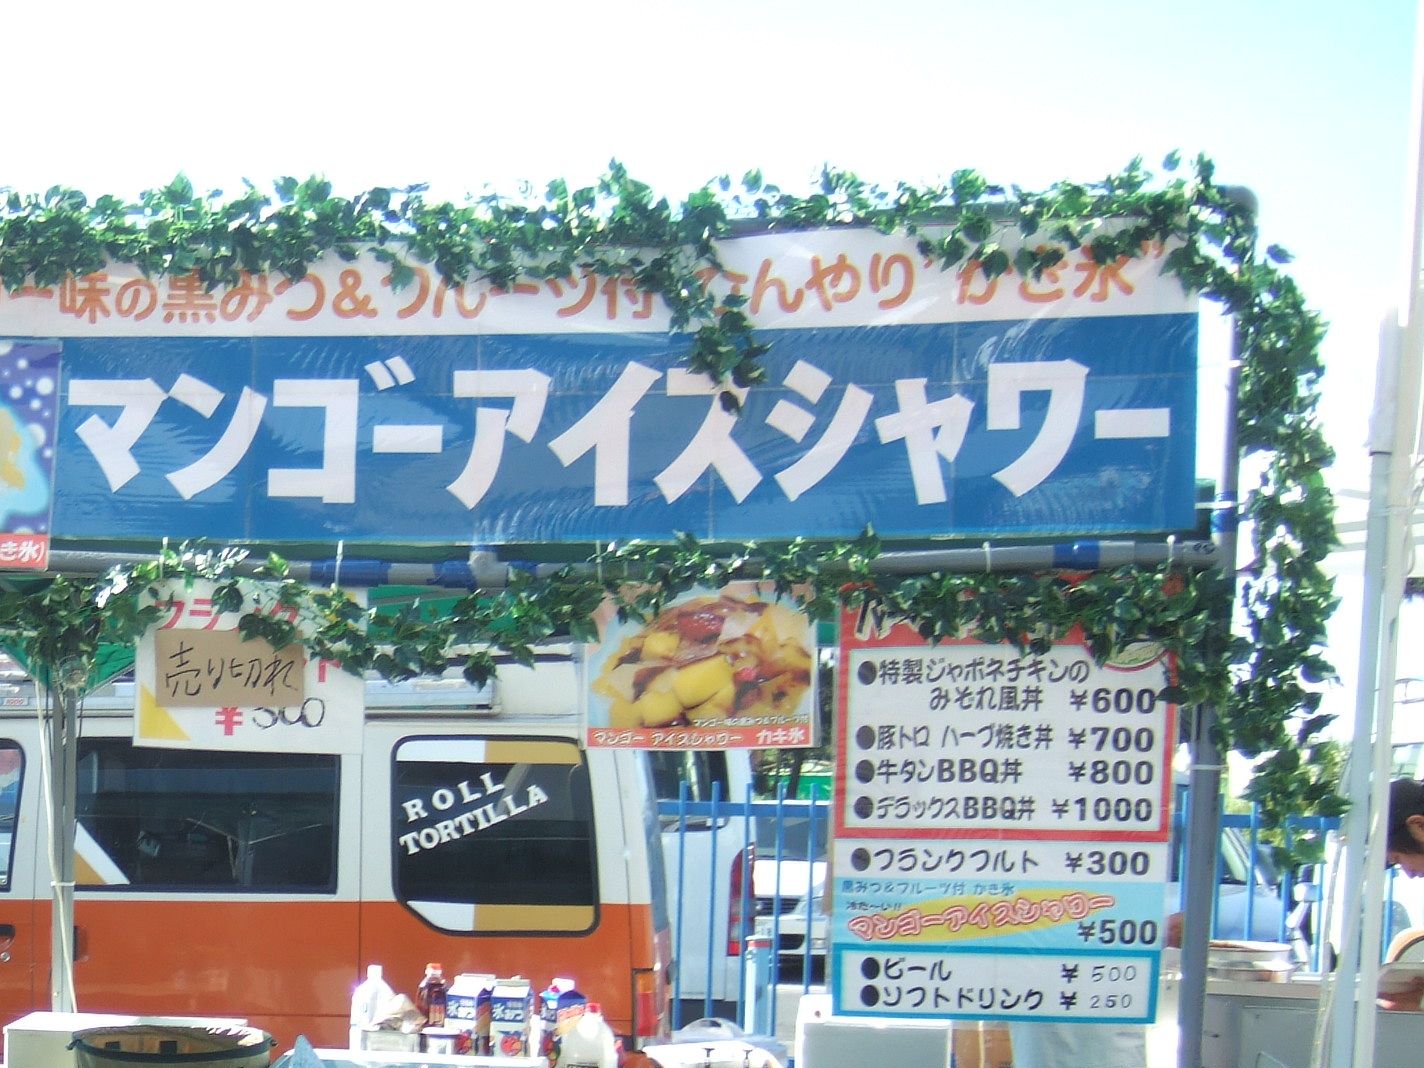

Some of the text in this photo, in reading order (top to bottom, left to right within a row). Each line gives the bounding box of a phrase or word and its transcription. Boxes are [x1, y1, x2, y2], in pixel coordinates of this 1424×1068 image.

[68, 356, 1170, 509] マンゴーアイスシャワー
[165, 641, 299, 697] 売り切れ
[879, 657, 1090, 685] 特製ジャポネチキンの
[1070, 687, 1157, 714] ¥600
[877, 724, 1155, 752] 豚トロ ハーブ焼き丼 ¥700
[877, 758, 1154, 786] 牛タンBBQ丼 ¥800
[401, 772, 505, 823] ROLL
[876, 795, 1153, 822] デラックスBBQ丼 ¥1000
[398, 784, 549, 855] TORTILLA
[873, 847, 1151, 876] フランクフルト ¥300
[848, 891, 1116, 941] マンゴーアイスシャワー
[1077, 919, 1158, 945] ¥500
[883, 957, 953, 981] ビール
[880, 983, 1044, 1010] ソフトドリンク
